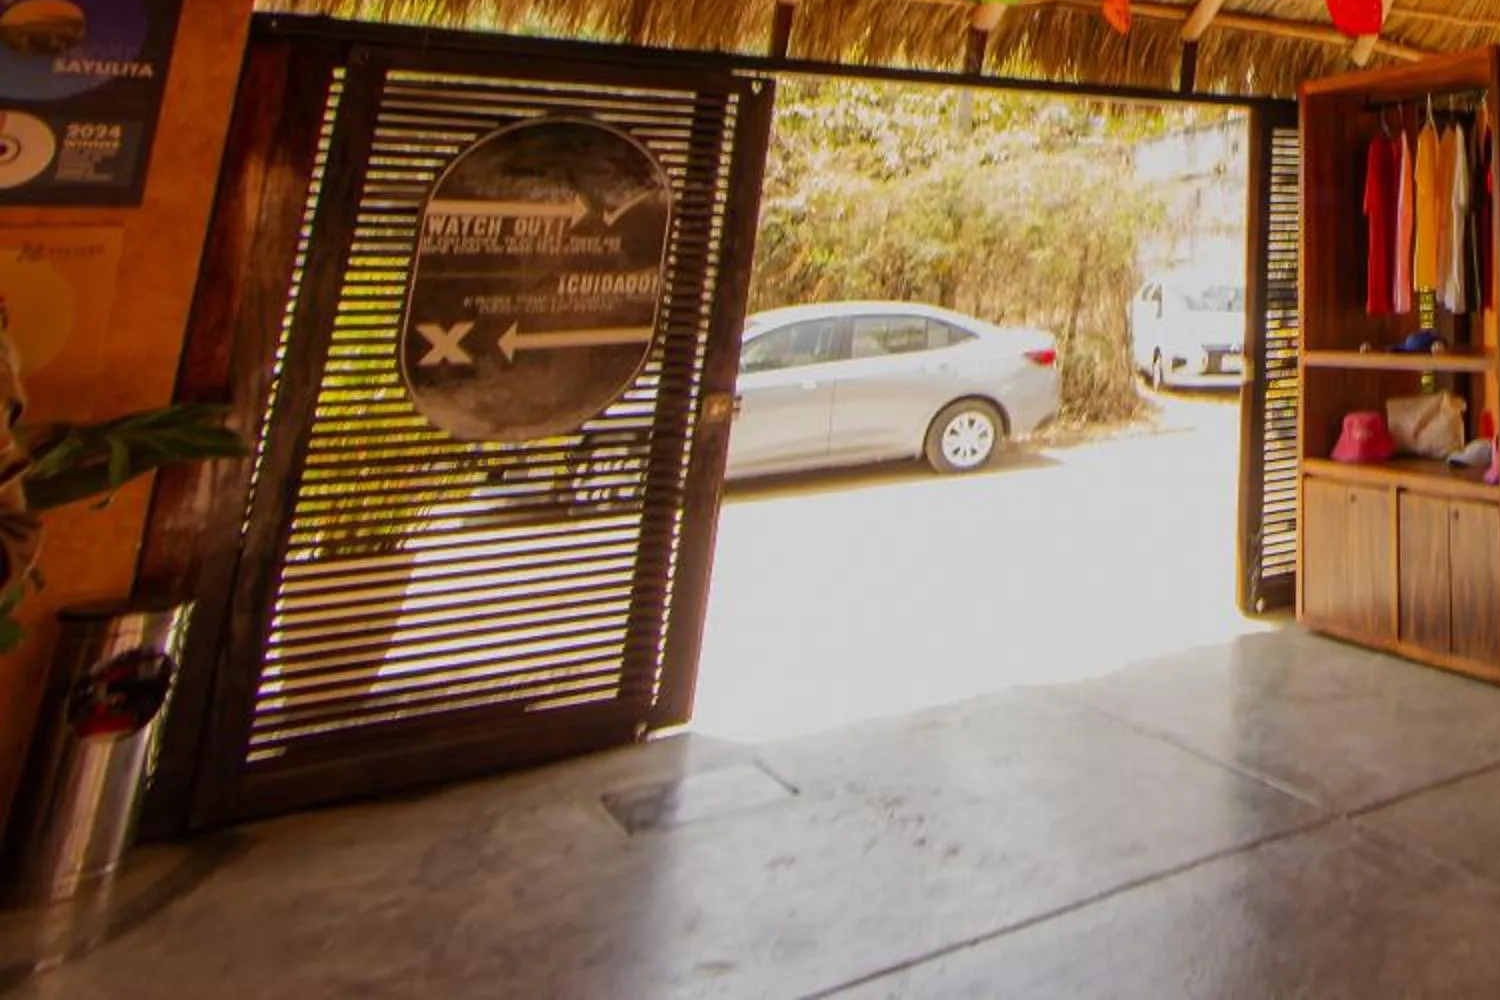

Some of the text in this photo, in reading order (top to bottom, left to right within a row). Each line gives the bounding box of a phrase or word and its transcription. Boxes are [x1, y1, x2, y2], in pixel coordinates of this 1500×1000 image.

[55, 58, 154, 78] SAYULITA
[66, 124, 121, 138] 2024
[427, 216, 565, 238] WATCH OUT!
